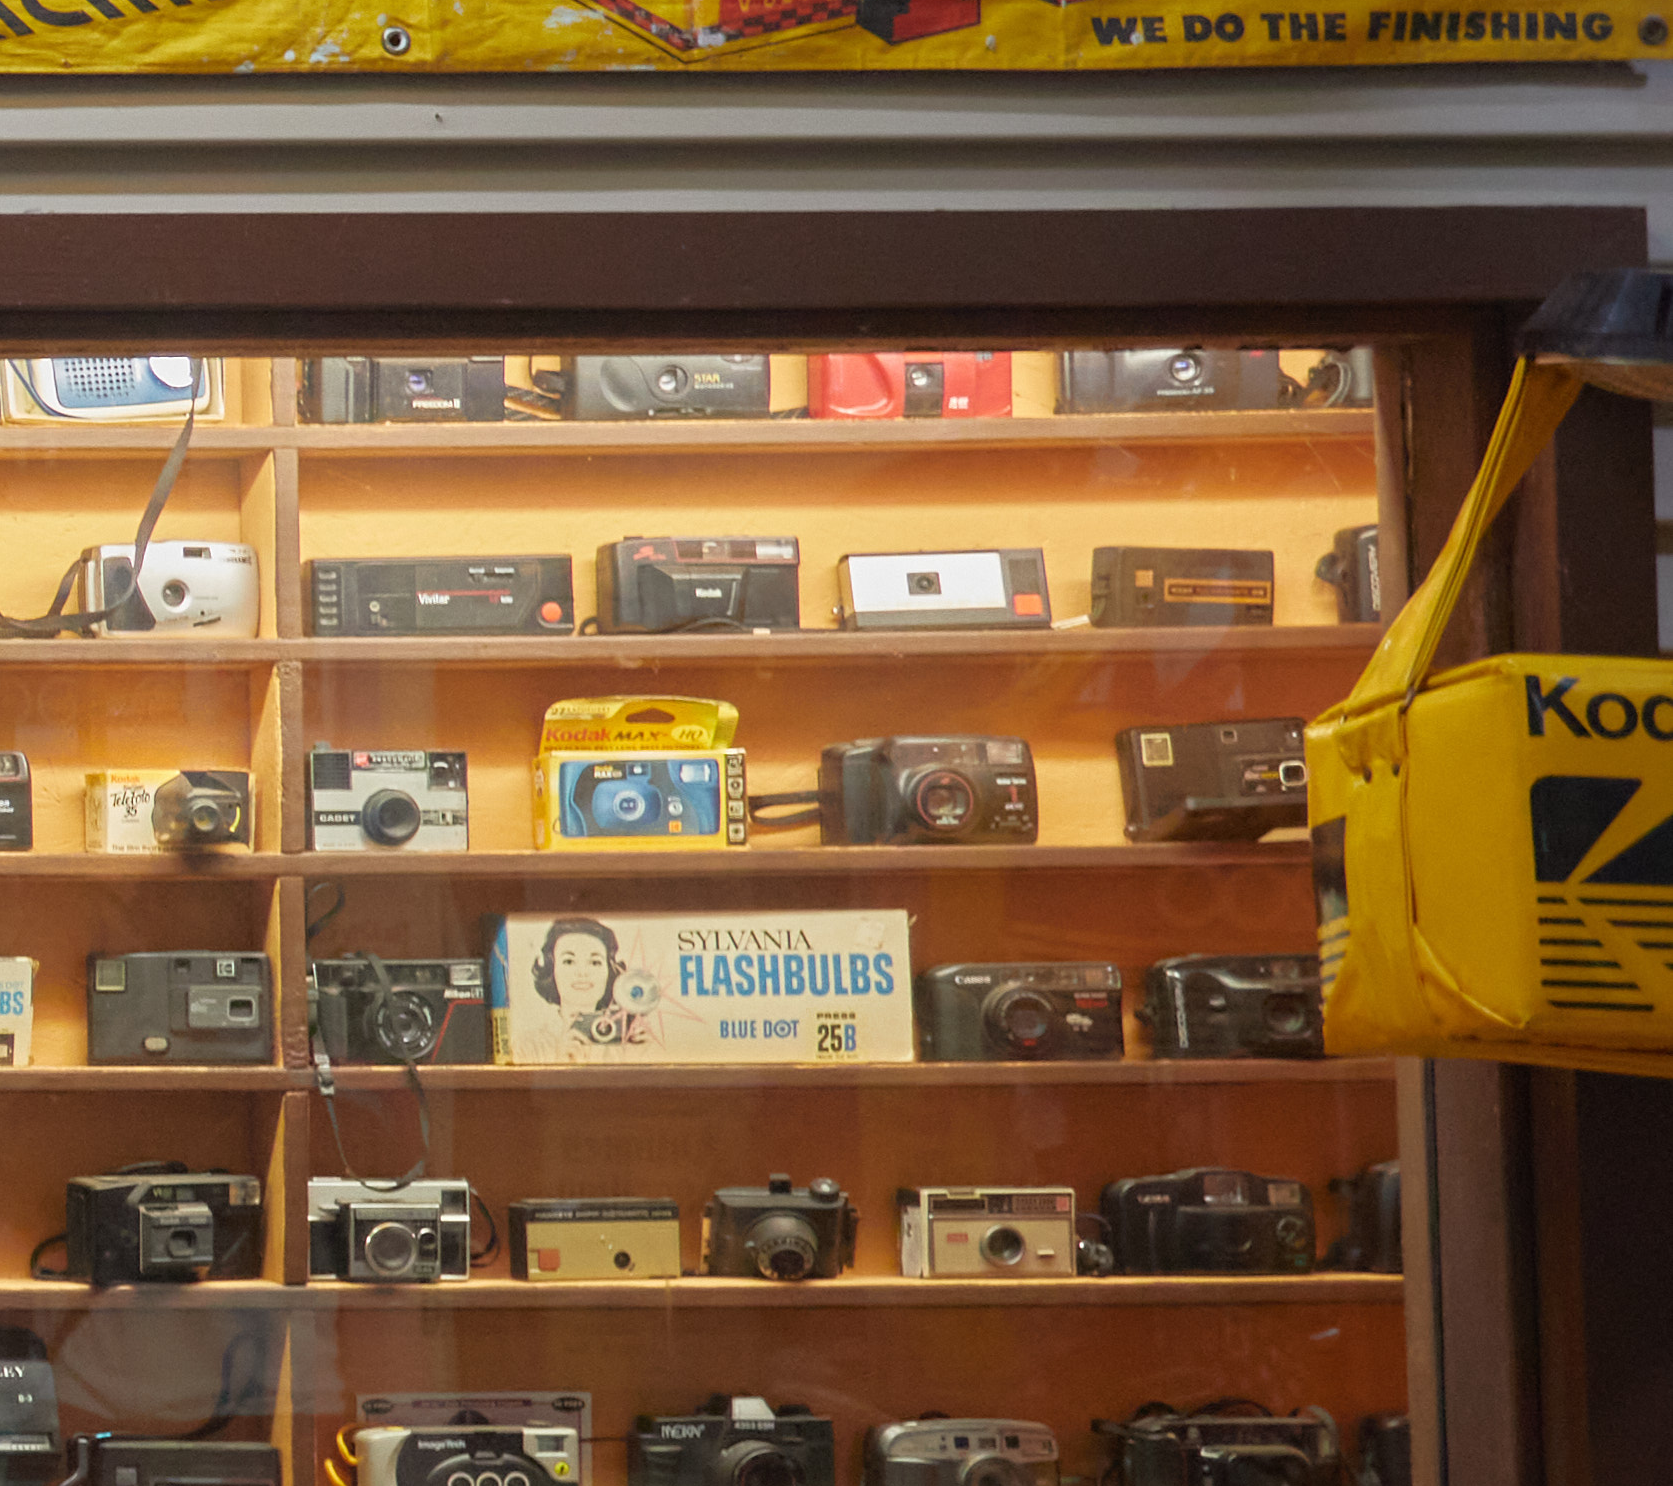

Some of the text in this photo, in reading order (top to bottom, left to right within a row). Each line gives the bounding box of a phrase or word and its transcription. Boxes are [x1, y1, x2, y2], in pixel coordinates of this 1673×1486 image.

[1091, 9, 1615, 46] WE DO THE FINISHING
[417, 593, 450, 605] Vivitar
[544, 724, 612, 745] Kodak
[614, 731, 664, 743] MAX
[110, 774, 141, 784] Kodak
[319, 814, 357, 824] CADET
[677, 929, 815, 951] SYLVANIA
[680, 953, 895, 997] FLASHBULBS
[719, 1019, 801, 1040] BLUE DOT
[816, 1023, 858, 1053] 25B
